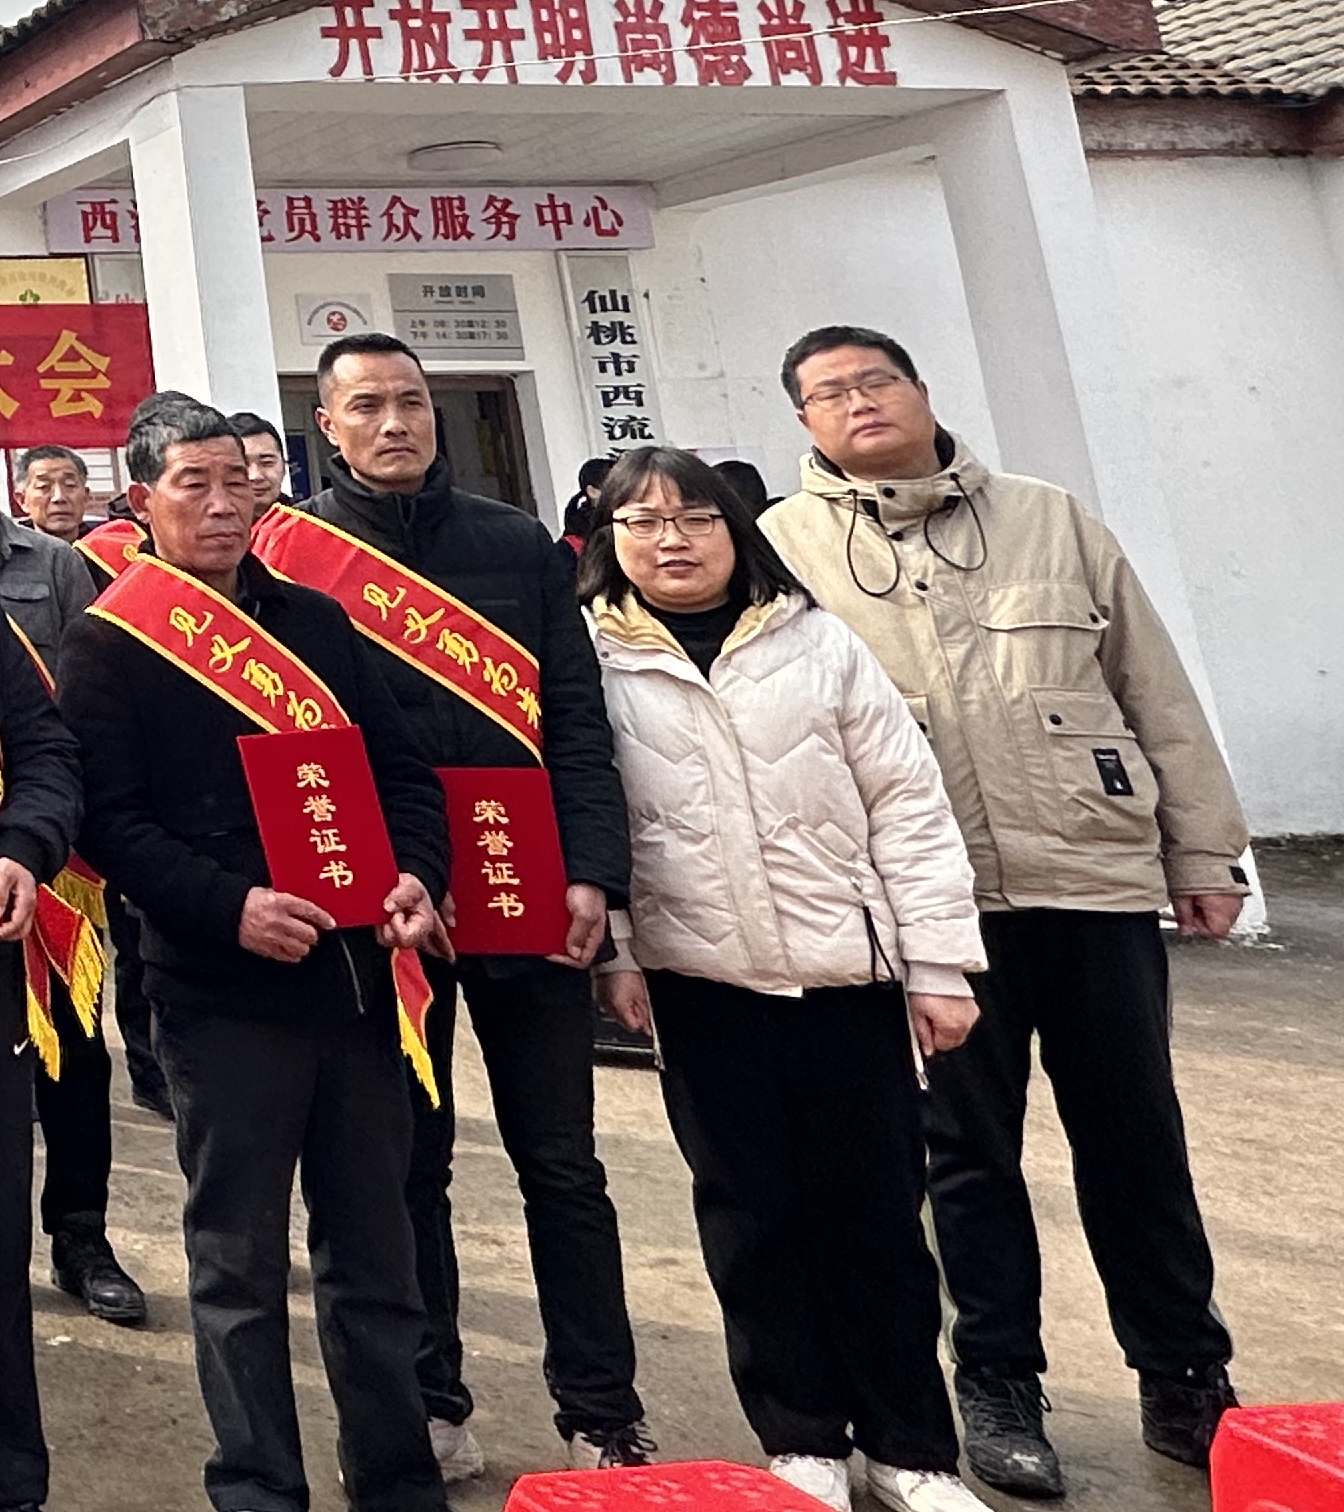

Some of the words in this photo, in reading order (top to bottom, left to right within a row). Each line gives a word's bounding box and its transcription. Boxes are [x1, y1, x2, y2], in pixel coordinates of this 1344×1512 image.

[422, 284, 486, 299] 开放时间
[580, 288, 655, 460] 仙桃市西流
[297, 762, 354, 889] 荣誉证书
[473, 799, 525, 918] 荣誉证书
